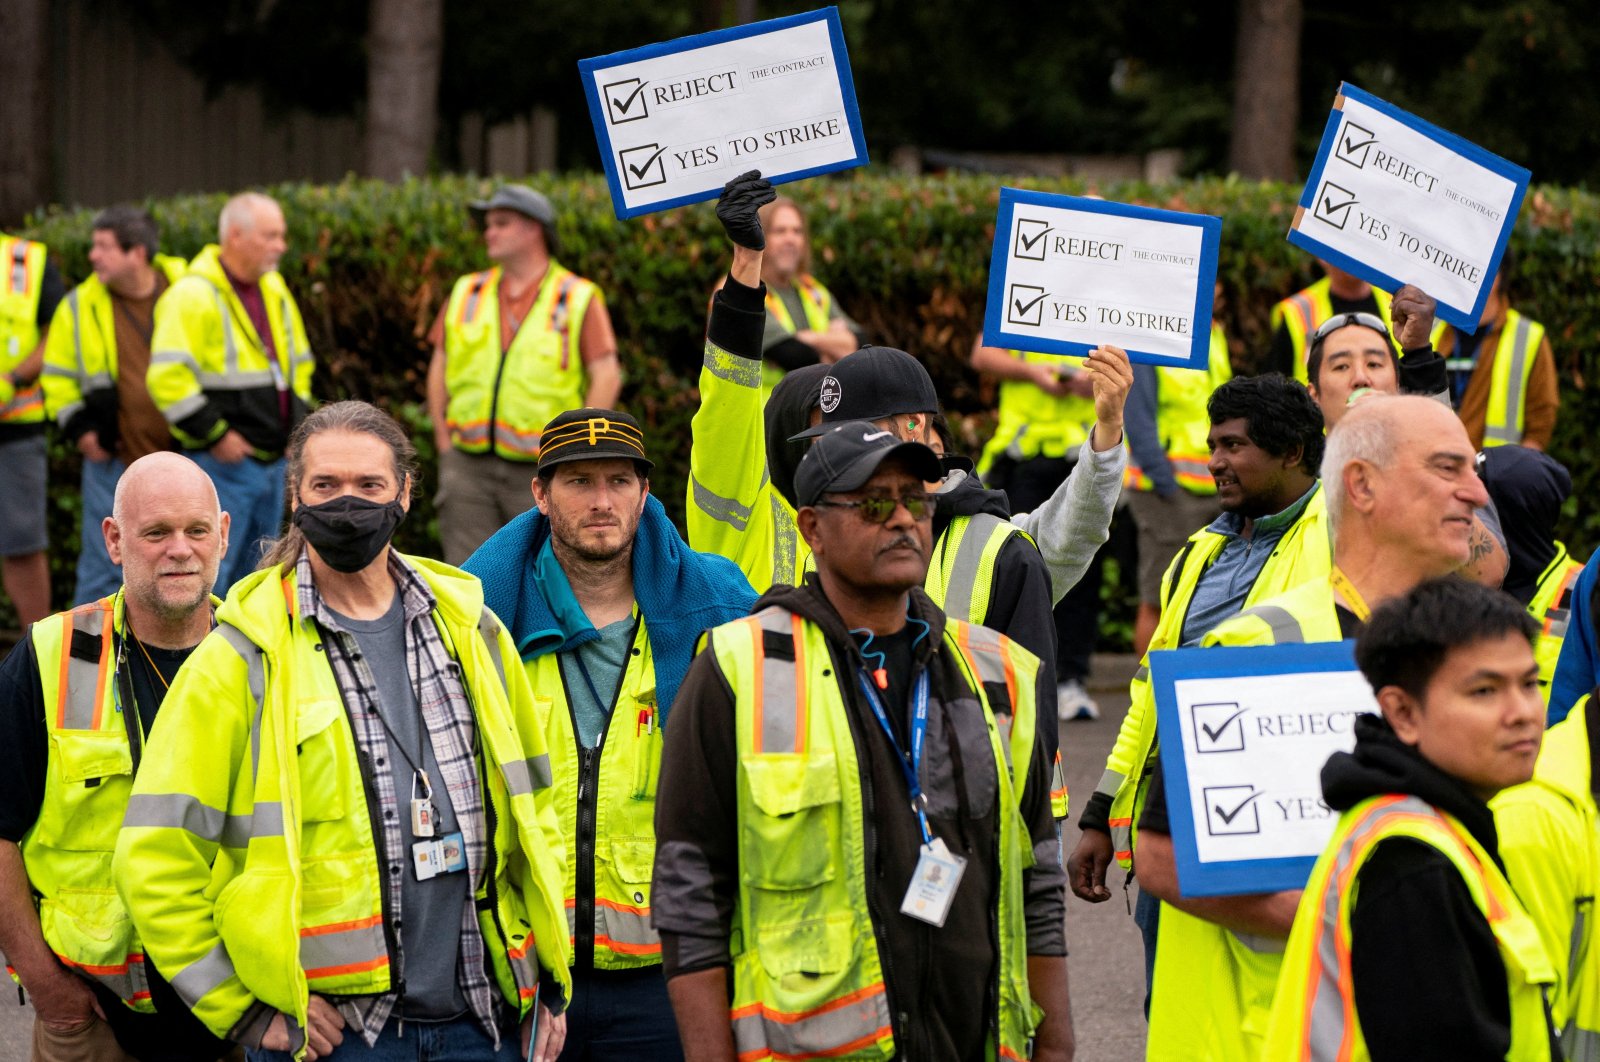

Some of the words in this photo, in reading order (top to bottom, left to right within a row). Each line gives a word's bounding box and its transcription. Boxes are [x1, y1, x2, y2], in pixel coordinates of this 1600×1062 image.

[653, 71, 737, 106] REJECT
[750, 67, 769, 80] THE
[771, 56, 825, 75] CONTRACT
[673, 145, 719, 170] YES
[728, 136, 759, 156] TO
[765, 118, 841, 150] STRIKE
[1373, 151, 1439, 193] REJECT
[1445, 189, 1459, 202] THE
[1460, 197, 1501, 221] CONTRACT
[1054, 236, 1123, 261] REJECT
[1133, 250, 1149, 259] THE
[1151, 252, 1194, 265] CONTRACT
[1358, 212, 1391, 241] YES
[1398, 231, 1420, 253] TO
[1421, 244, 1480, 283] STRIKE
[1053, 302, 1087, 322] YES
[1098, 307, 1121, 324] TO
[1126, 312, 1188, 334] STRIKE
[588, 418, 609, 445] P
[1275, 799, 1331, 821] YES
